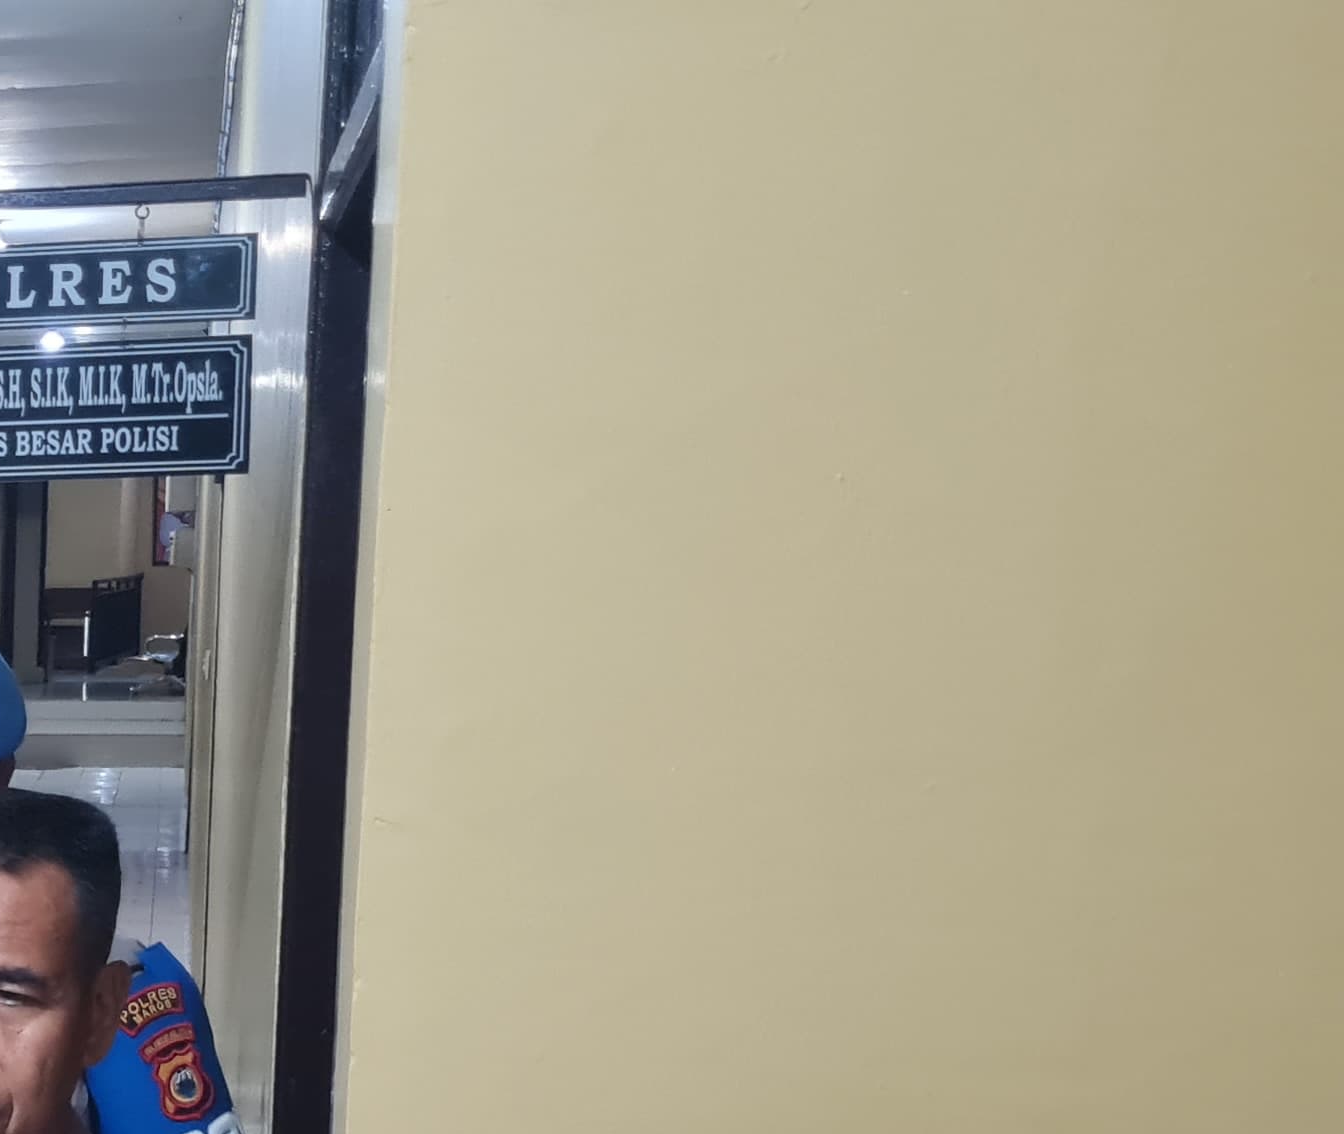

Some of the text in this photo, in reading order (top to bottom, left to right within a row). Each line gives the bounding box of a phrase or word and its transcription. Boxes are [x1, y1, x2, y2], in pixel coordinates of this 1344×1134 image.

[29, 365, 73, 416] S.I.K,
[79, 364, 126, 415] M.I.K,
[15, 429, 92, 456] BESAR
[100, 425, 179, 454] POLISI
[119, 986, 177, 1024] POLRES
